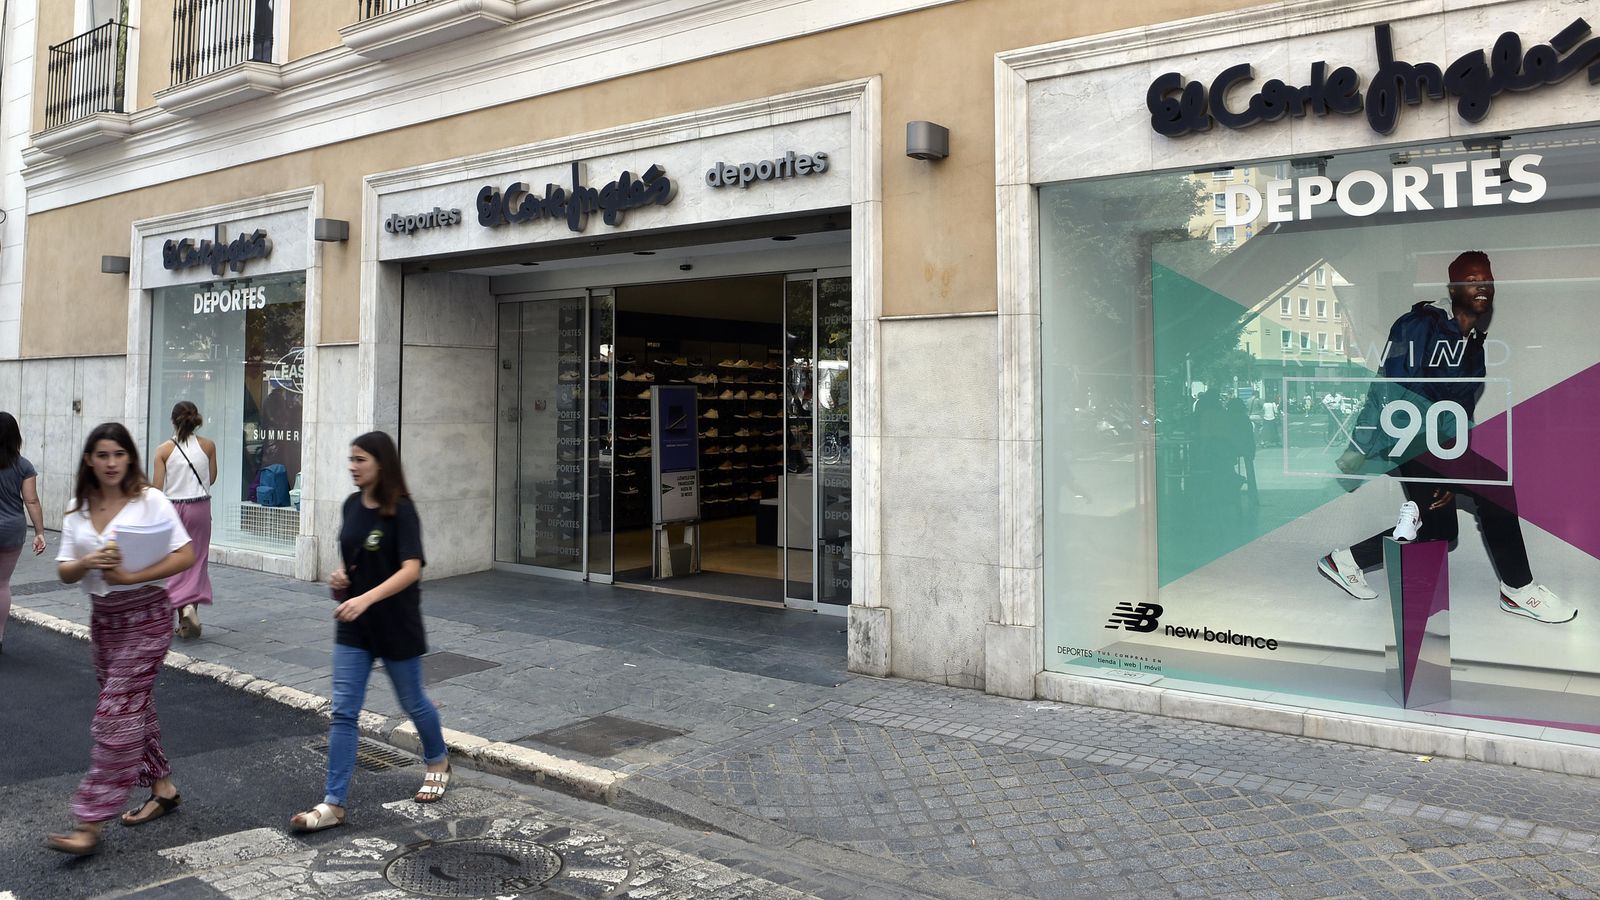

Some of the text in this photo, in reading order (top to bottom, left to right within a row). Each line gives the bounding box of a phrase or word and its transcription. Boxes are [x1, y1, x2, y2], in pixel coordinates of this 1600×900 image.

[1147, 72, 1213, 137] El
[1208, 60, 1364, 129] Corte
[705, 151, 829, 189] deportes
[384, 160, 678, 235] deportes El Corte Inglés
[1225, 154, 1548, 227] DEPORTES
[193, 286, 266, 315] DEPORTES
[1282, 339, 1511, 367] REWIND
[253, 429, 300, 441] SUMMER
[1057, 645, 1093, 658] DEPORTES
[1165, 625, 1199, 638] new
[1204, 627, 1278, 650] balance
[1097, 658, 1117, 666] tienda
[1144, 663, 1162, 672] móvil
